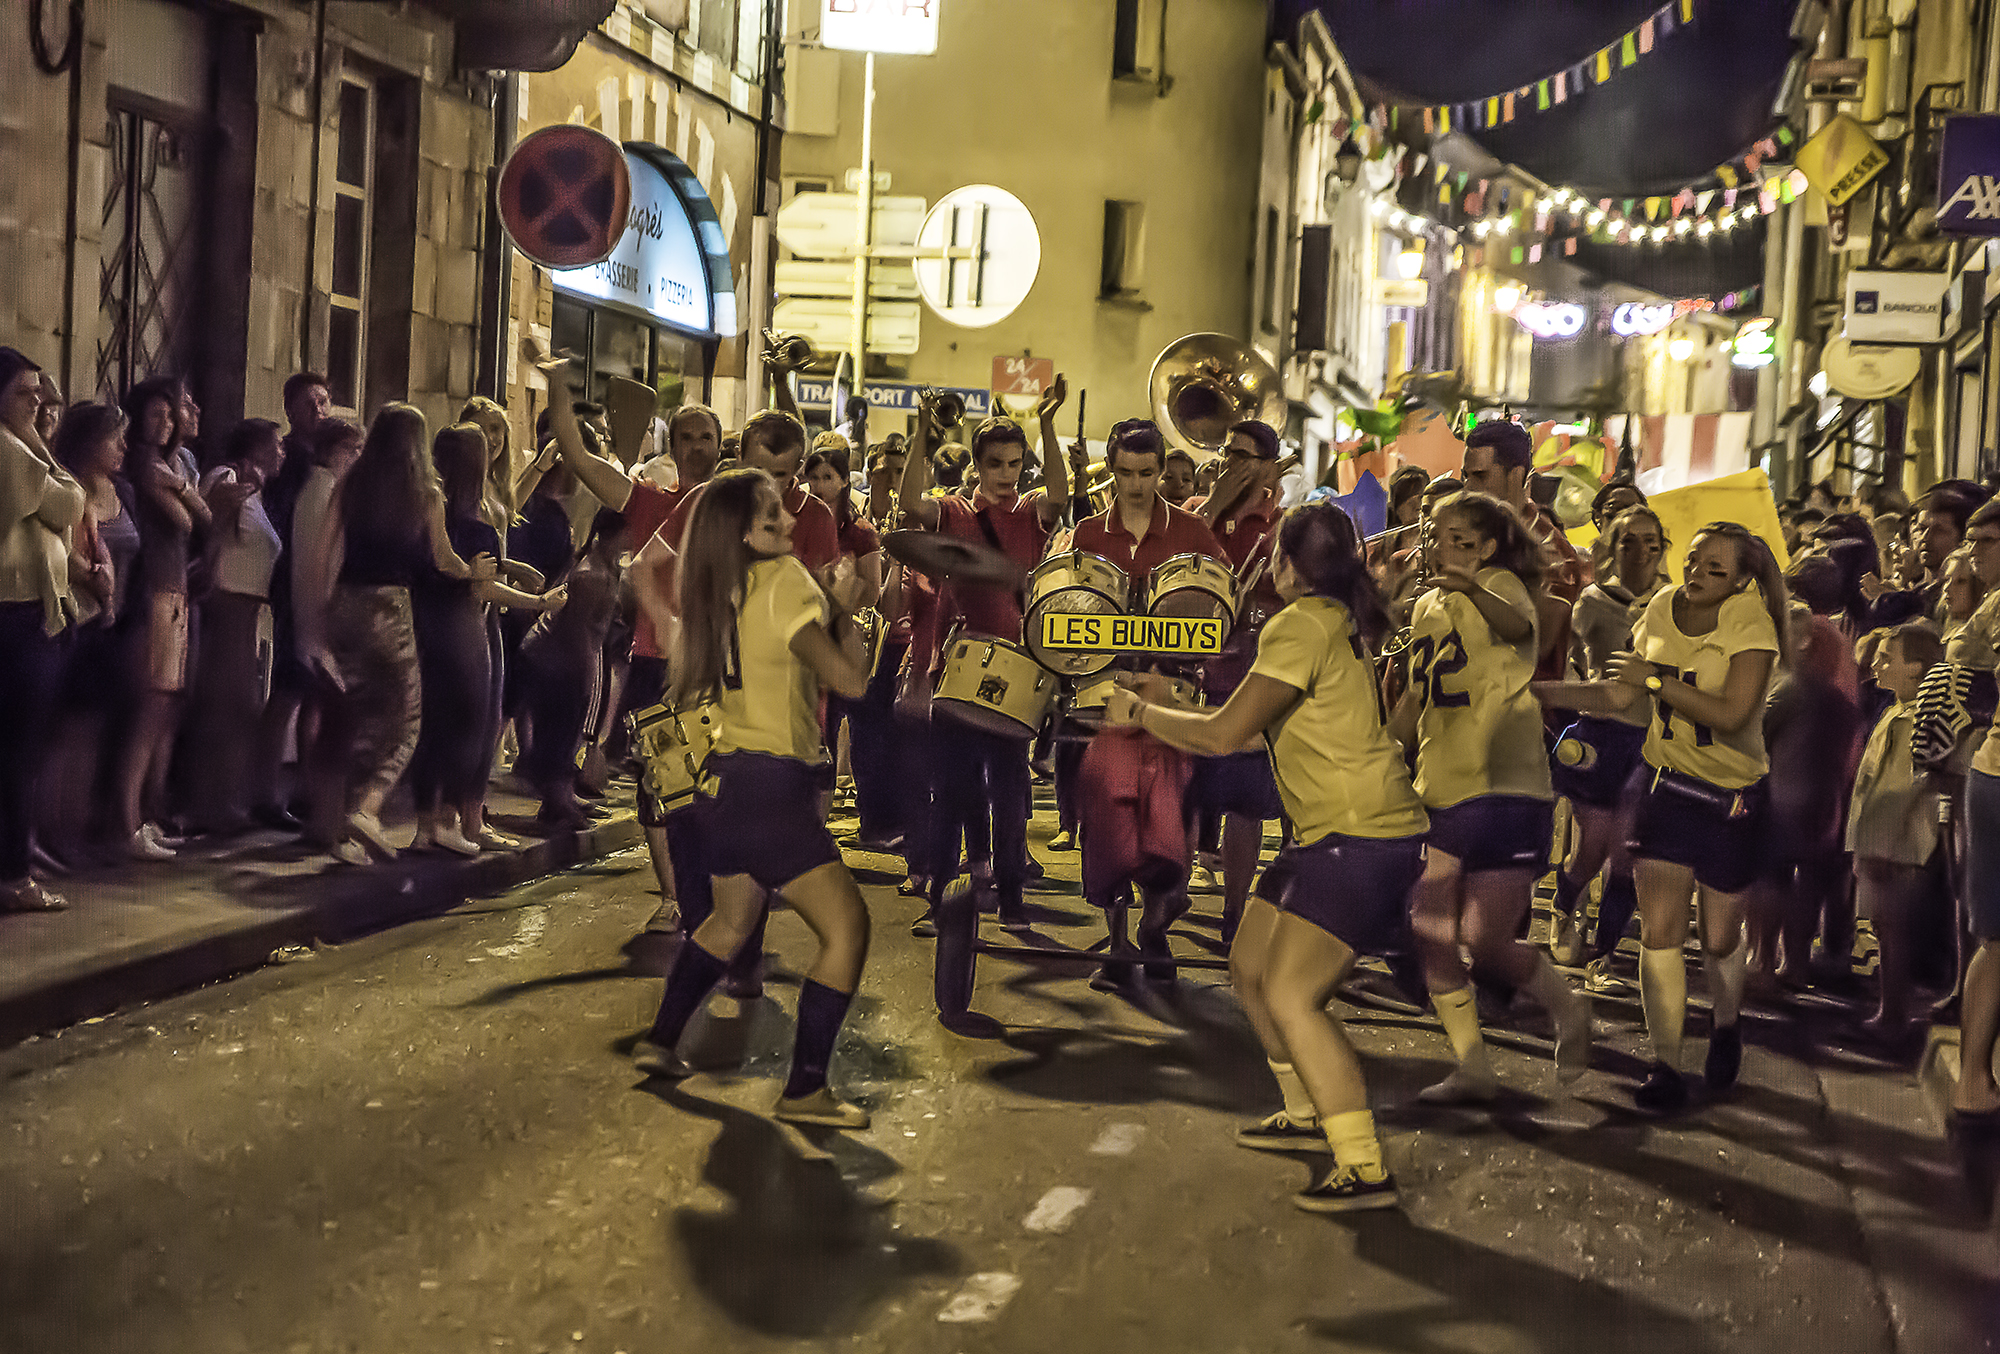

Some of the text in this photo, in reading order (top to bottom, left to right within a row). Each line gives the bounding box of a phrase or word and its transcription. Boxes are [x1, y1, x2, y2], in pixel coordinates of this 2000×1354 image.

[595, 260, 693, 307] BRASSERIE PIZZERIA
[800, 383, 906, 407] TRAPORT
[1049, 617, 1217, 649] LES BUNDYS
